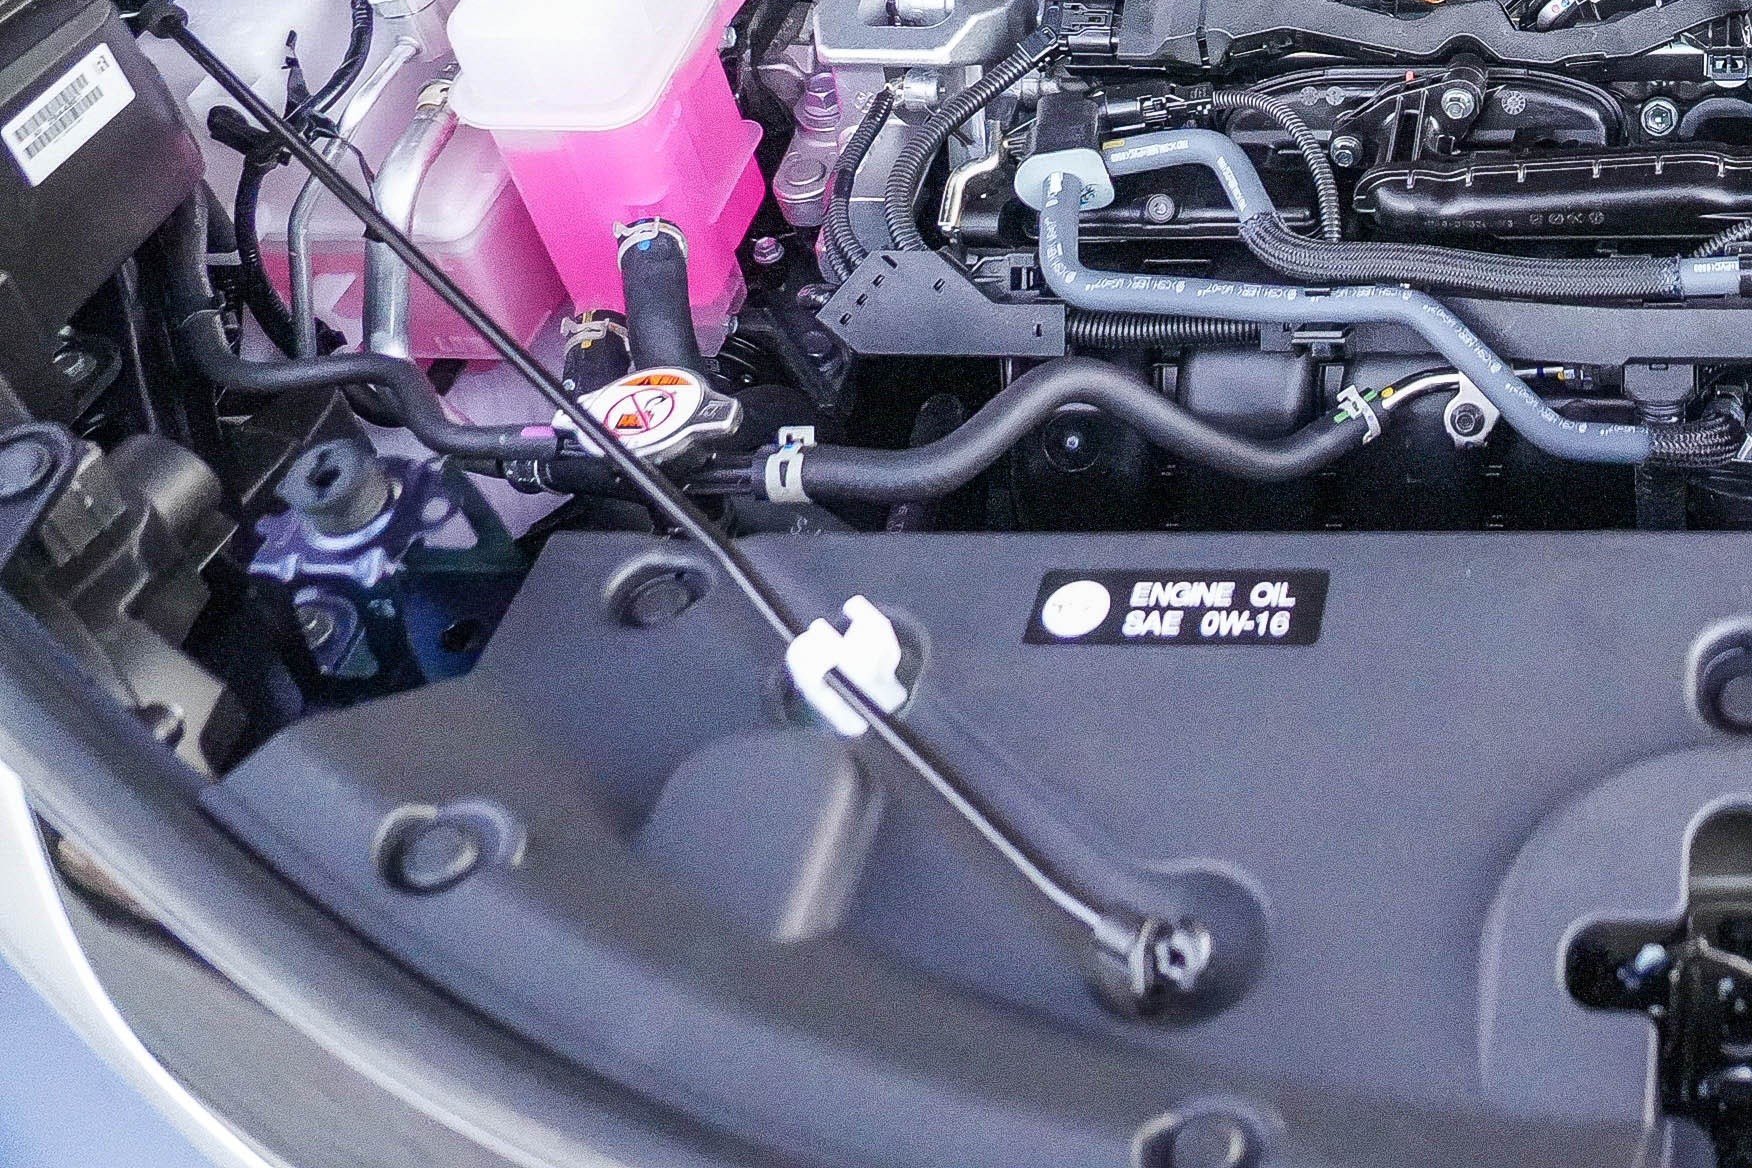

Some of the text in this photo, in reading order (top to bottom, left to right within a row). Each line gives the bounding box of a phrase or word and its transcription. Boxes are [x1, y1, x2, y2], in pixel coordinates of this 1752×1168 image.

[1129, 580, 1297, 608] ENGINE OIL
[1121, 609, 1292, 637] SAE 0W-16
